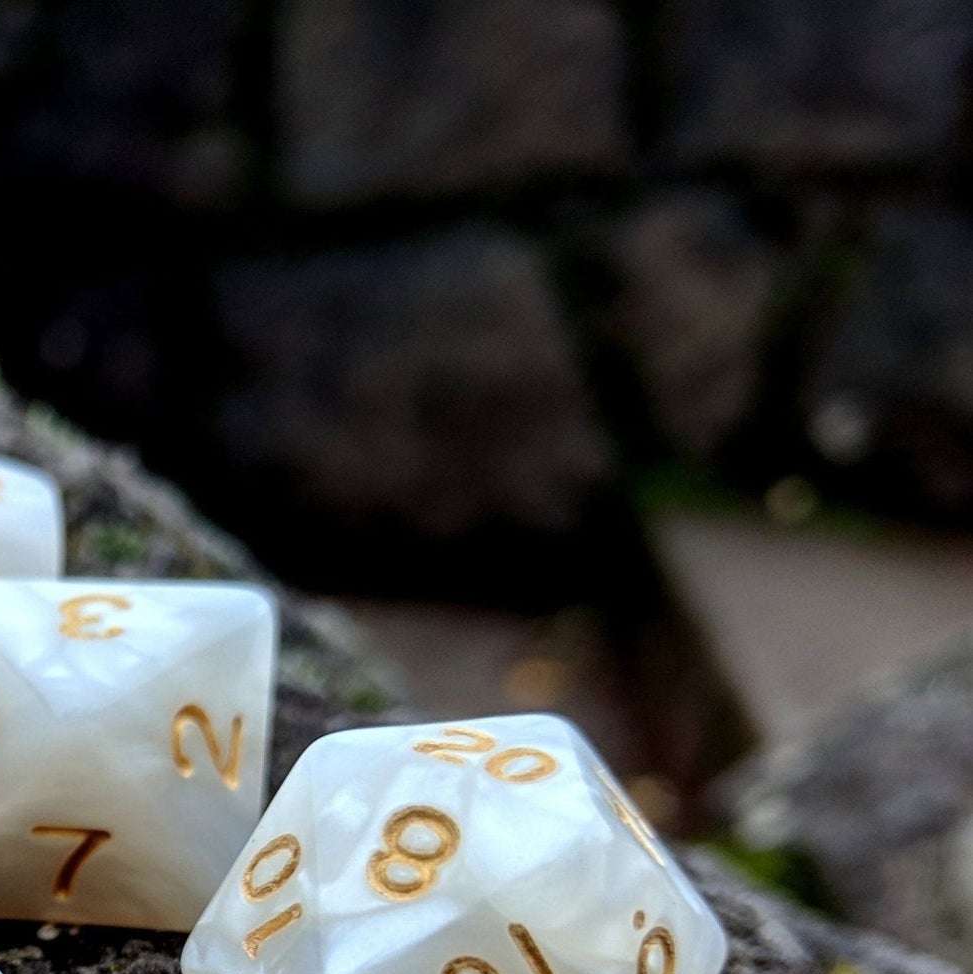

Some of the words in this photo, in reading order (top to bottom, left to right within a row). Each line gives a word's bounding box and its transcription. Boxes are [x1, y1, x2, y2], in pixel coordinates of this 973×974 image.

[58, 594, 130, 640] 3
[171, 704, 243, 790] 2
[413, 728, 559, 784] 20
[32, 826, 111, 901] 7
[366, 804, 460, 902] 8
[241, 832, 303, 960] 10
